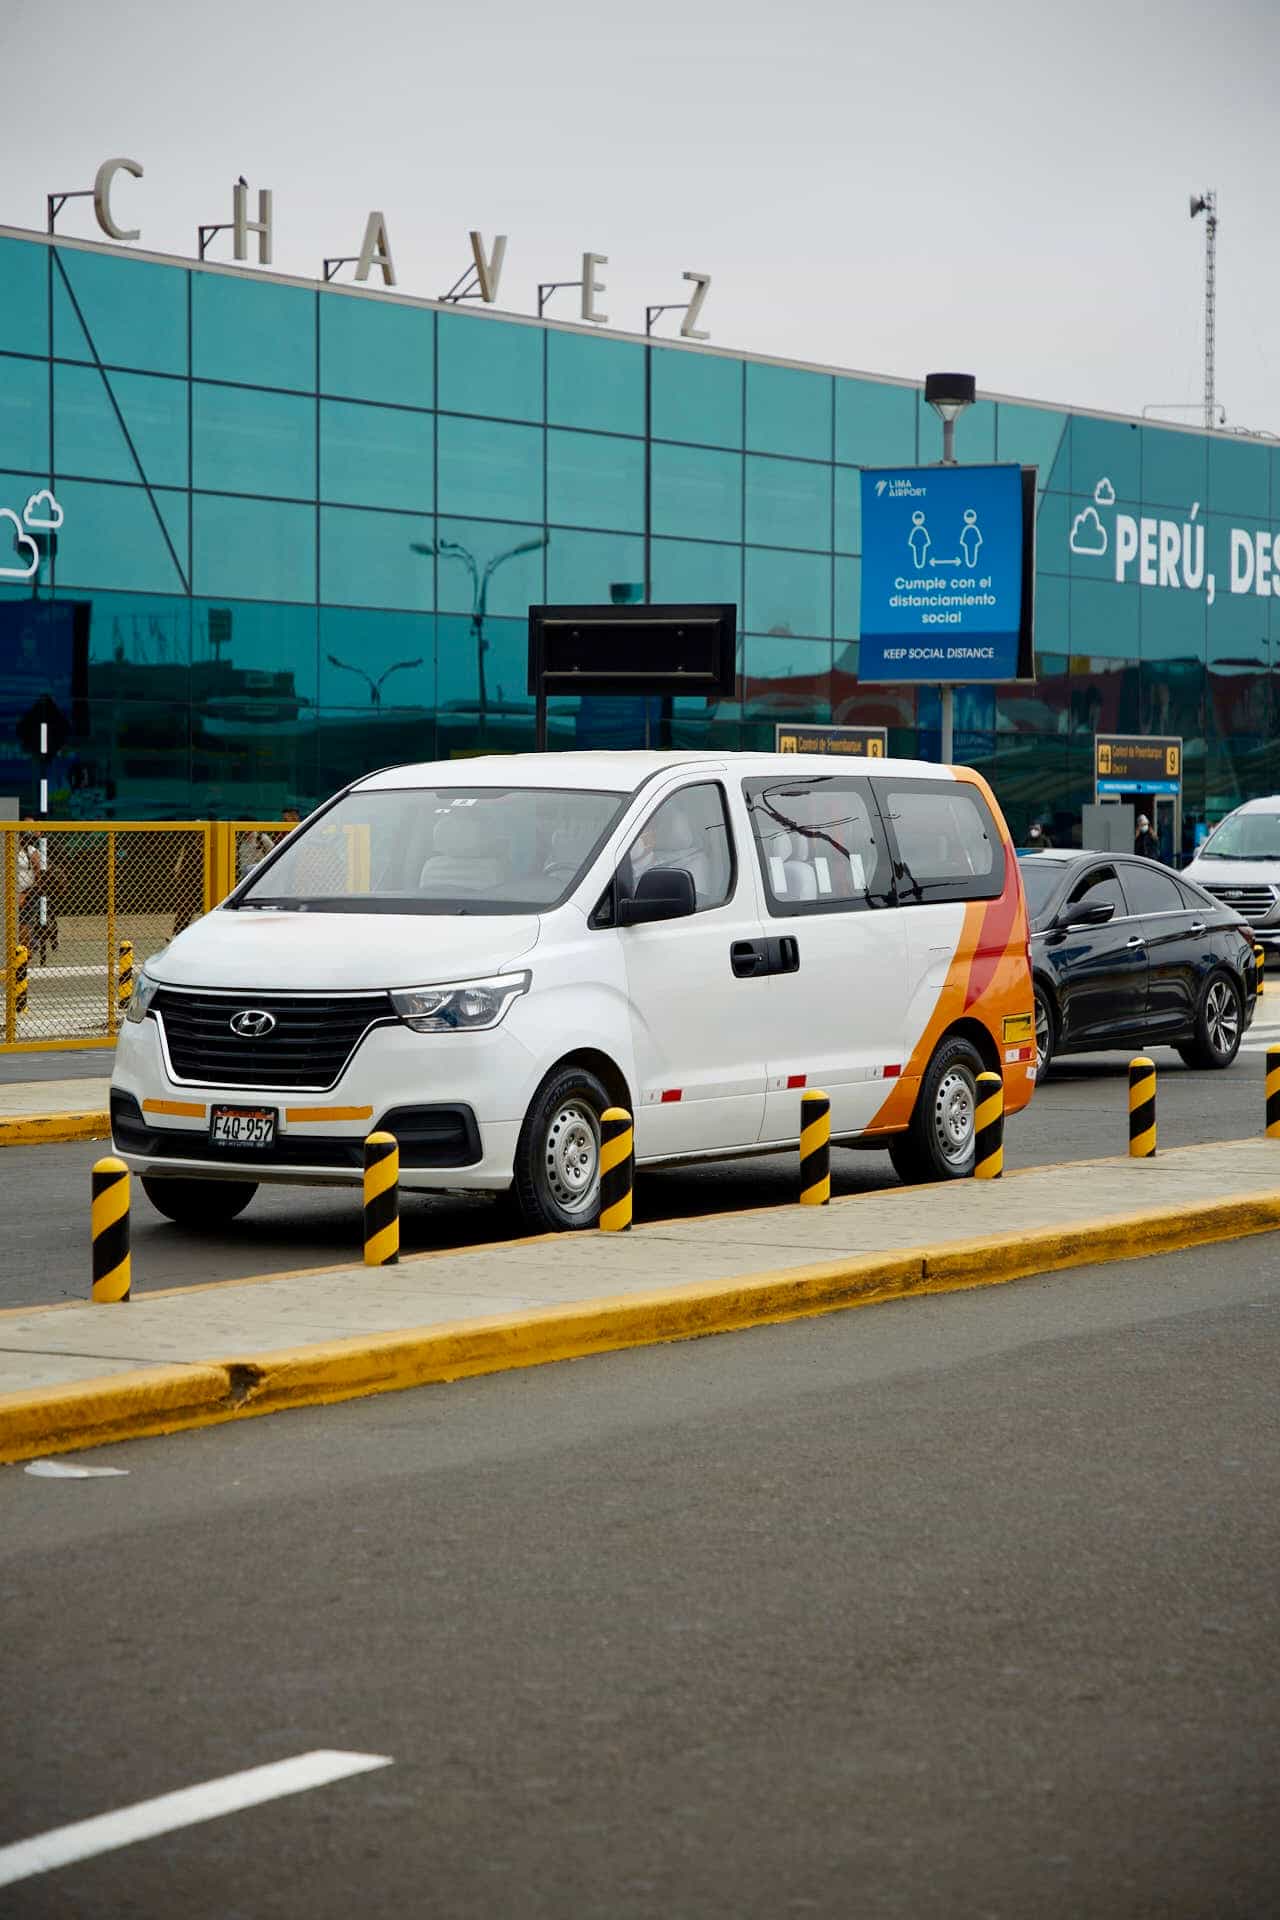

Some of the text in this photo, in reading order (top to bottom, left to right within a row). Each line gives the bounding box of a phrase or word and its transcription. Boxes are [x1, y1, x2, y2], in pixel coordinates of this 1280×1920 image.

[94, 158, 711, 339] CHAVEZ
[889, 479, 912, 488] LIMA
[889, 488, 926, 497] AIRPORT
[1116, 502, 1215, 606] PERÚ,
[894, 576, 992, 592] Cumple con el
[889, 593, 997, 607] distanciamiento
[921, 611, 962, 624] social
[883, 647, 995, 660] KEEP SOCIAL DISTANCE
[1169, 751, 1176, 771] 9
[213, 1116, 273, 1141] F4Q-957
